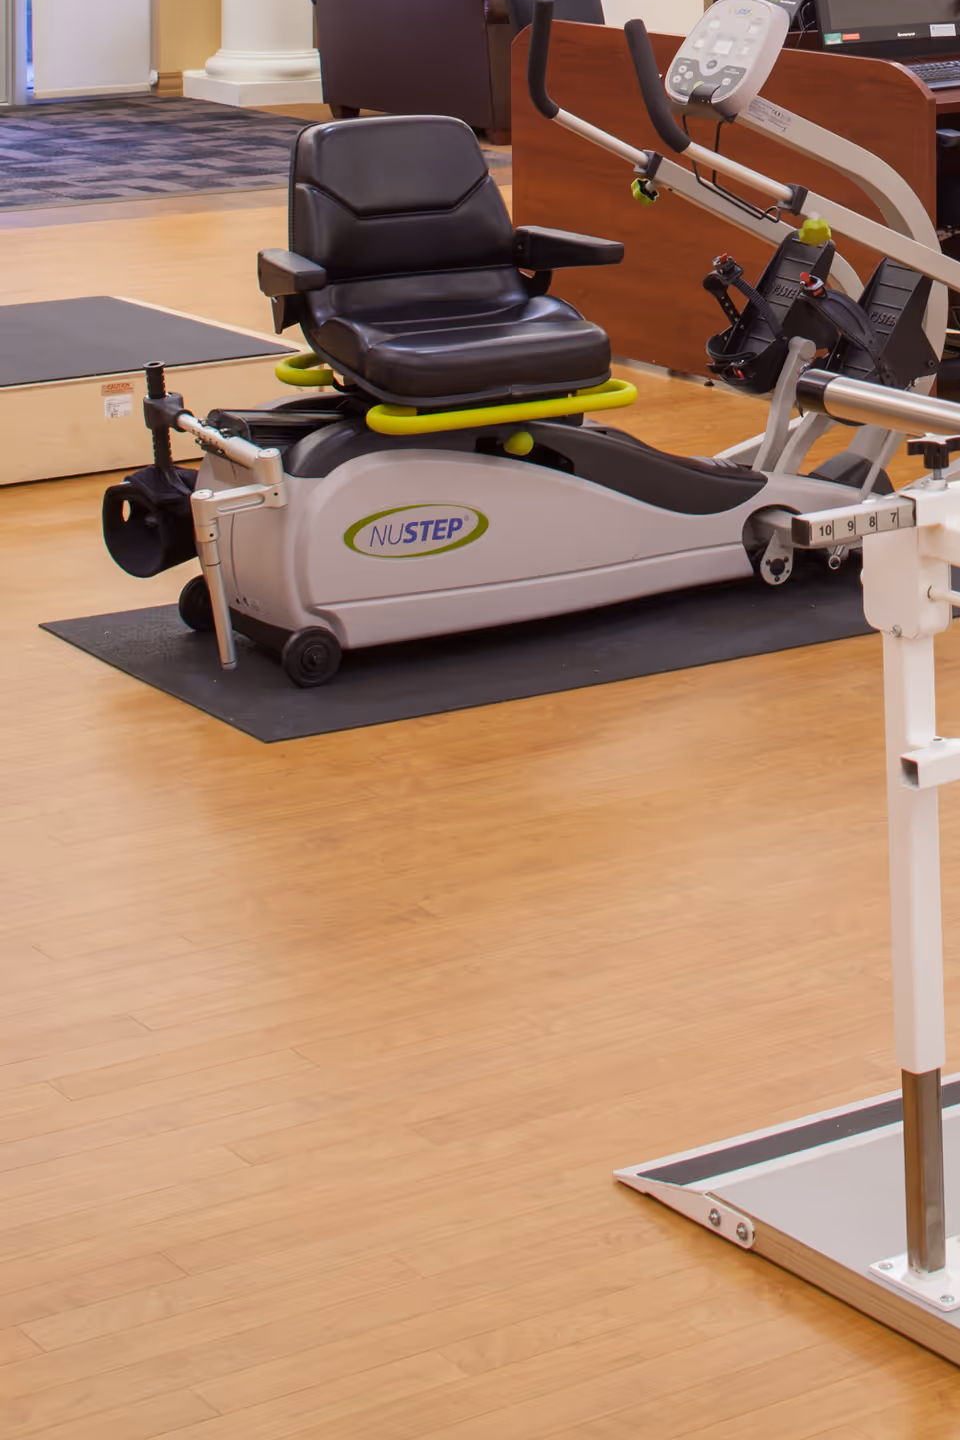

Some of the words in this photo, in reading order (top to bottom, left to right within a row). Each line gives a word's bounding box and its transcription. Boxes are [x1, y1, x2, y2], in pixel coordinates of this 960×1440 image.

[369, 517, 464, 547] NUSTEP
[819, 525, 832, 537] 10
[847, 520, 854, 531] 9
[869, 516, 876, 528] 8
[890, 512, 897, 523] 7
